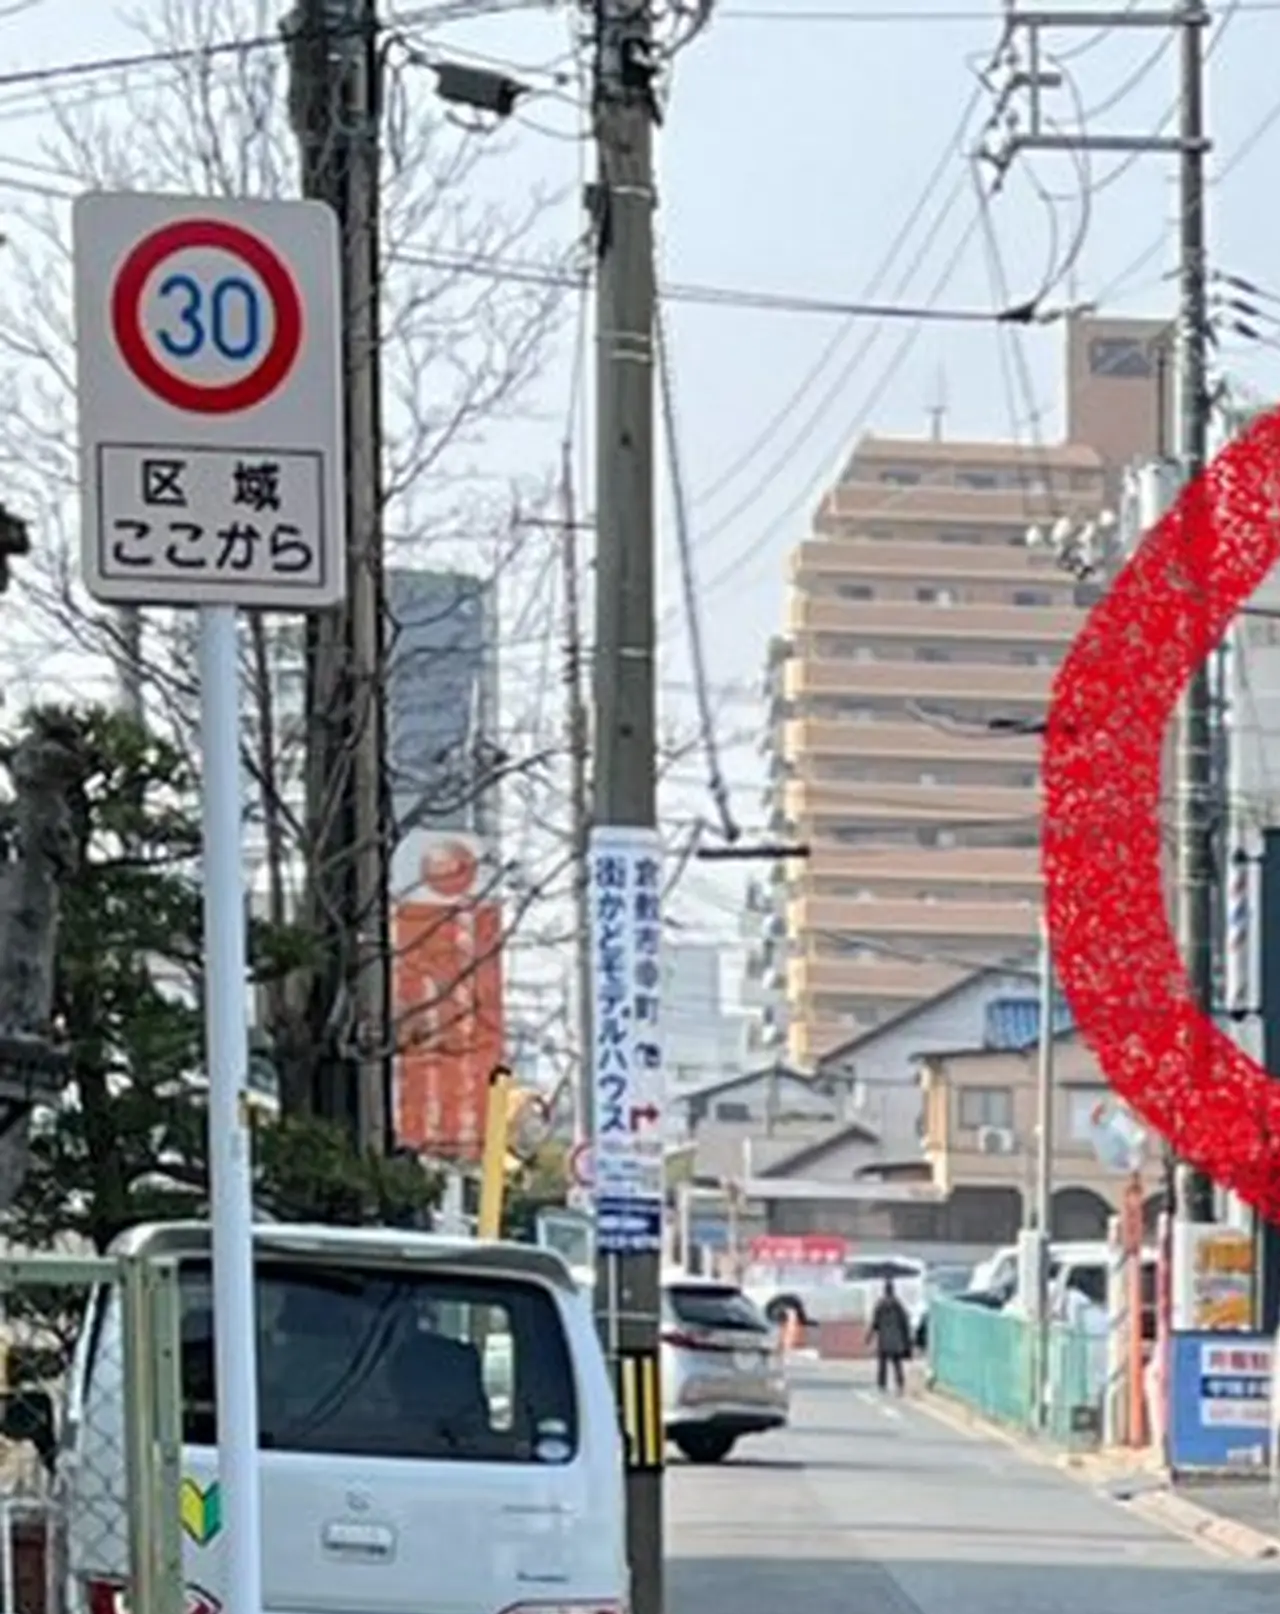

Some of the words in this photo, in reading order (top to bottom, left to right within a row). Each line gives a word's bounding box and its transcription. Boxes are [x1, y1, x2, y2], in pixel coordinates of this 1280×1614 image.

[154, 274, 260, 360] 30
[142, 458, 281, 512] 区域
[111, 519, 314, 574] ここから
